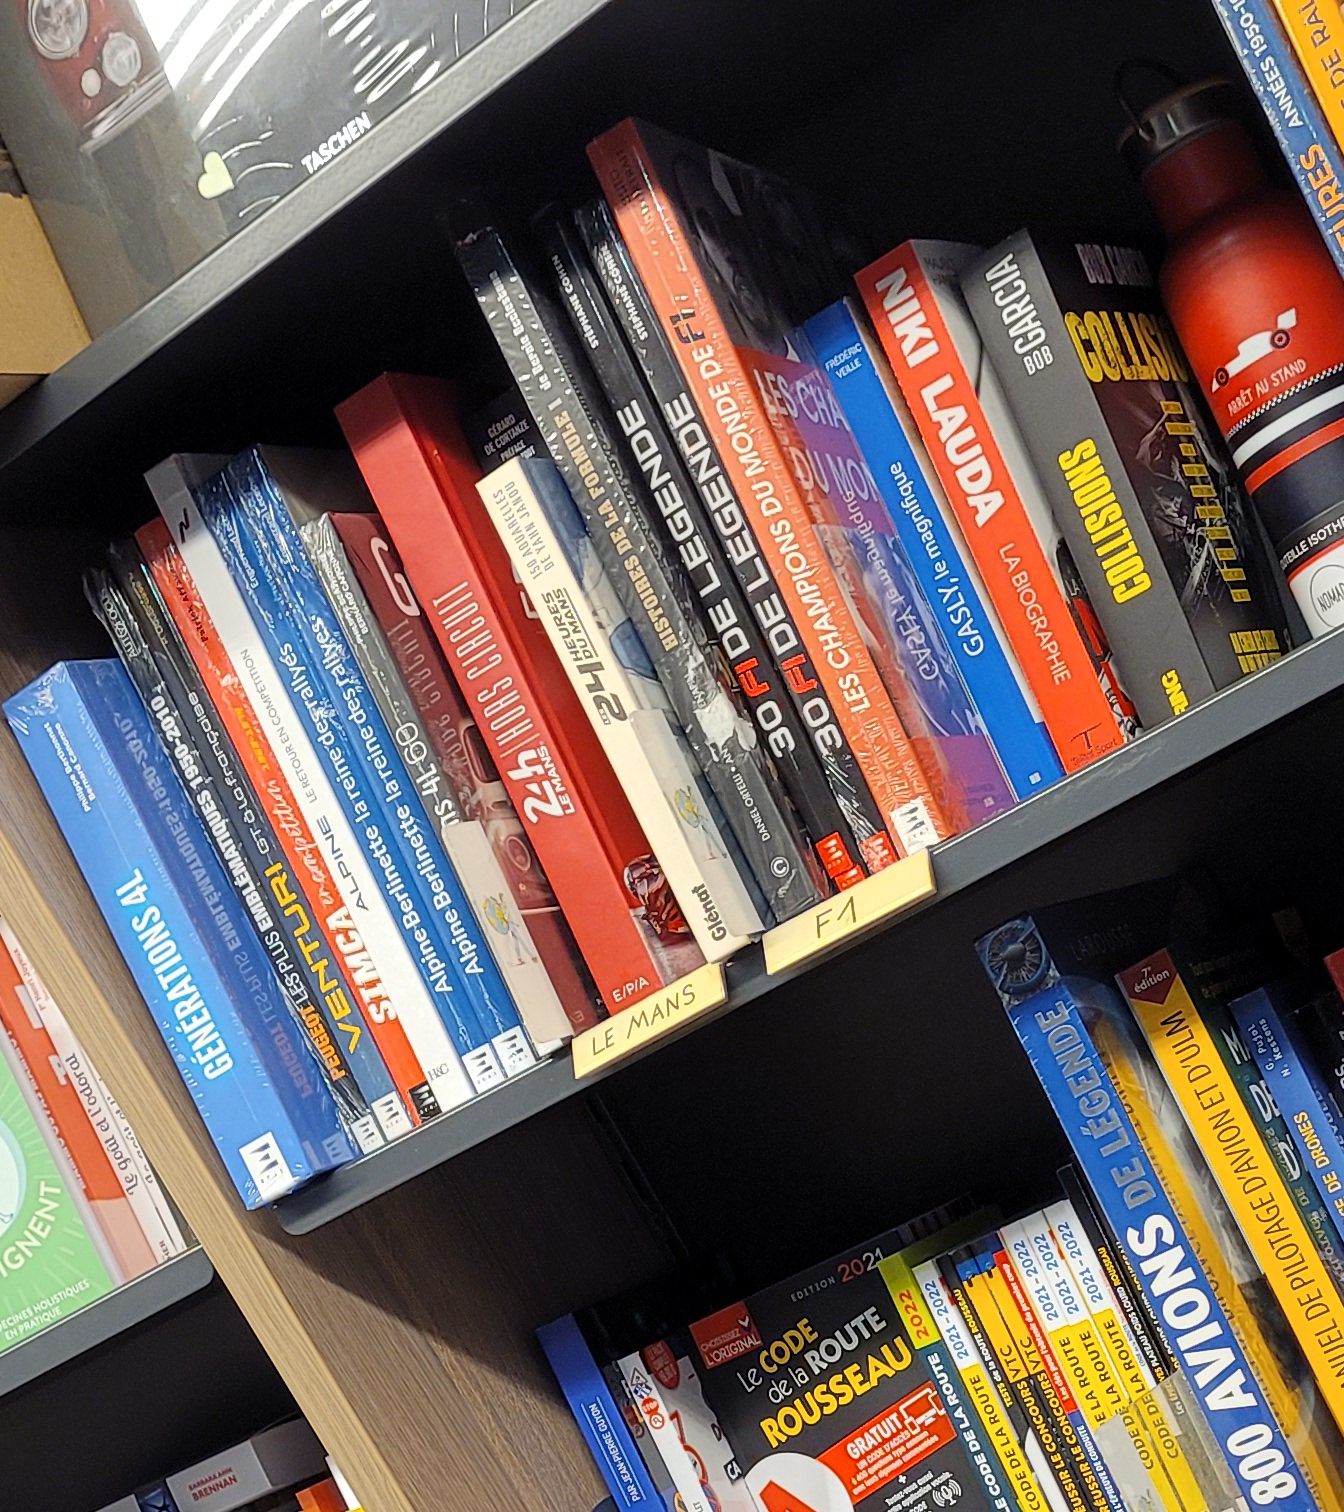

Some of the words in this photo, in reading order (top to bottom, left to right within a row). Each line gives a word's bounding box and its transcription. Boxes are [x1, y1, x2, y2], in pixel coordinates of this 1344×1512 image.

[300, 111, 373, 175] TASCHEN
[984, 253, 1048, 357] GARCIA
[875, 268, 940, 370] NIKI
[920, 375, 1006, 528] LAUDA
[1023, 346, 1054, 376] BOB
[1227, 388, 1258, 417] ARRÊT
[1256, 381, 1271, 398] AU
[1271, 359, 1306, 393] STAND
[1059, 438, 1152, 604] COLLISIONS
[999, 543, 1021, 575] LA
[1013, 574, 1073, 685] BIOGRAPHIE
[115, 868, 147, 900] 4L
[316, 816, 369, 912] ALPINE
[264, 861, 363, 1054] VENTURI
[815, 896, 858, 938] F1
[132, 906, 235, 1082] GÉNÉRATIONS
[324, 906, 398, 1026] SIMCA
[592, 1027, 615, 1056] LE
[626, 983, 696, 1040] MANS
[1037, 1001, 1132, 1158] LÉGENDE
[1109, 1167, 1157, 1210] DE
[838, 1246, 886, 1283] 2021
[736, 1369, 764, 1394] Le
[758, 1319, 820, 1375] CODE
[768, 1380, 794, 1405] de
[787, 1367, 809, 1389] la
[809, 1308, 888, 1376] ROUTE
[1128, 1214, 1259, 1413] AVIONS
[759, 1336, 913, 1448] ROUSSEAU
[846, 1413, 904, 1461] GRATUIT
[1226, 1424, 1297, 1507] 800
